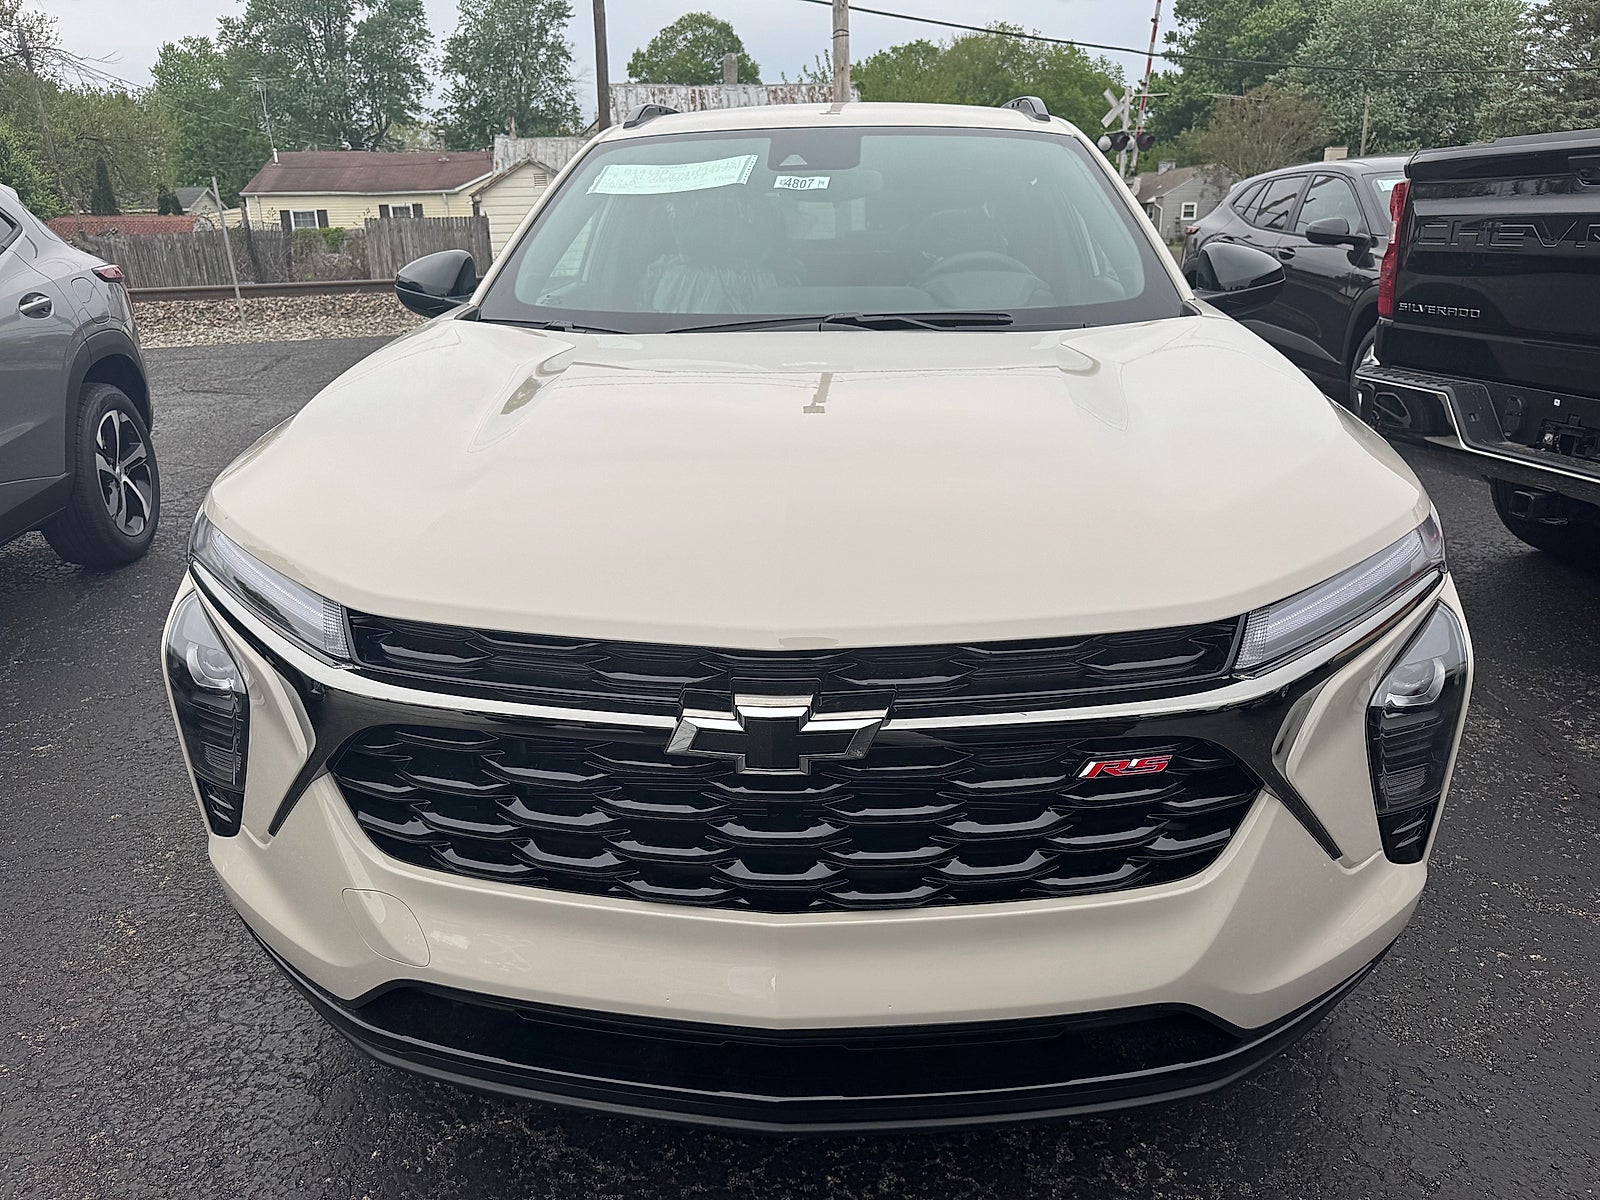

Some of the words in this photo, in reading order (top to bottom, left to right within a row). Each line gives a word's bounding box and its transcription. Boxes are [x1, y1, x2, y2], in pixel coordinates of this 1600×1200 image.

[784, 178, 815, 189] 4807
[1398, 302, 1481, 318] SILVERADO
[1078, 755, 1173, 779] RS
